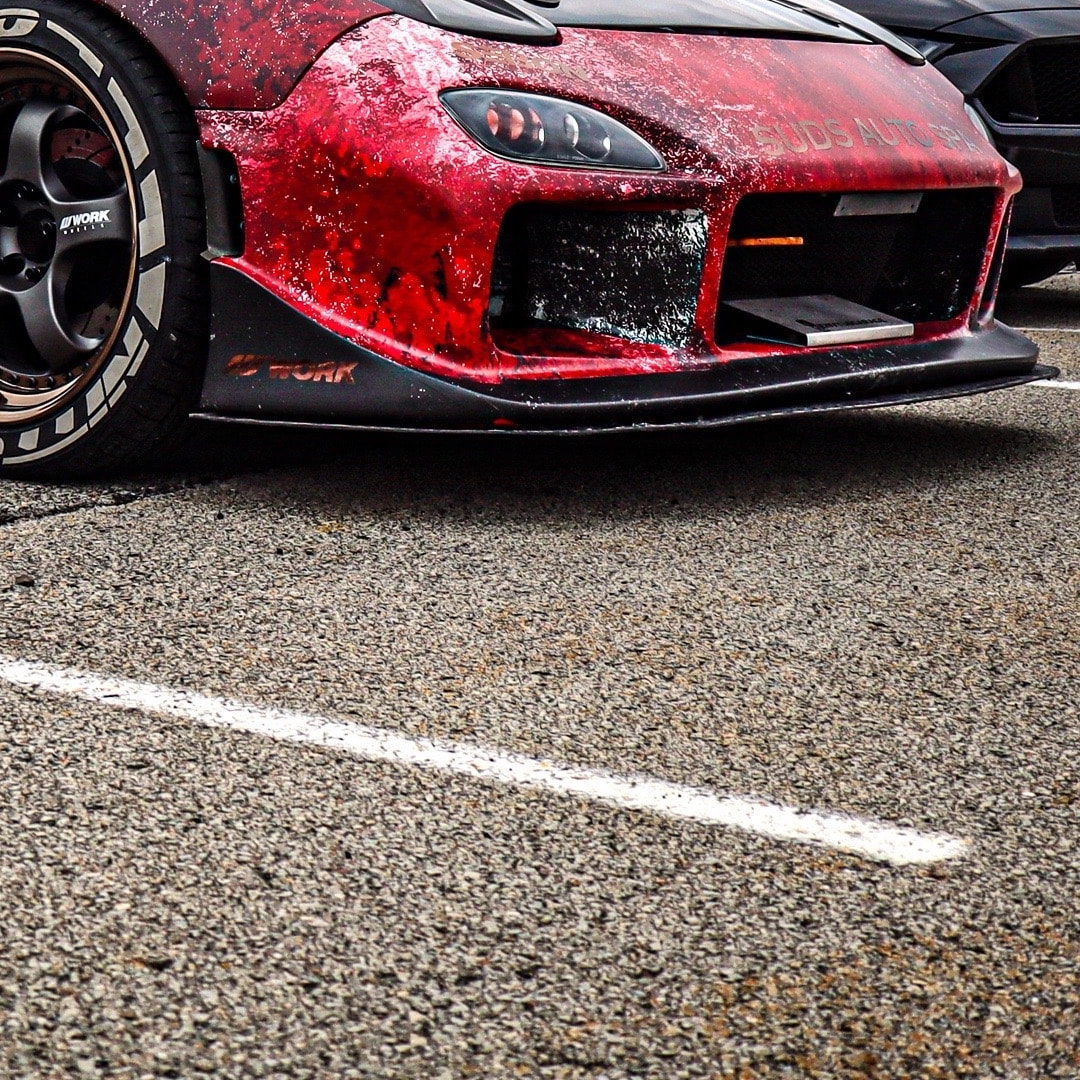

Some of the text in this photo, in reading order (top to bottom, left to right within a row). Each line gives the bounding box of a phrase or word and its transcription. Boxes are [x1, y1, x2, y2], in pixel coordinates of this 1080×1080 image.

[752, 118, 854, 157] SUDS
[853, 117, 934, 148] AUTO
[71, 209, 111, 226] WORK
[268, 361, 360, 385] WORK
